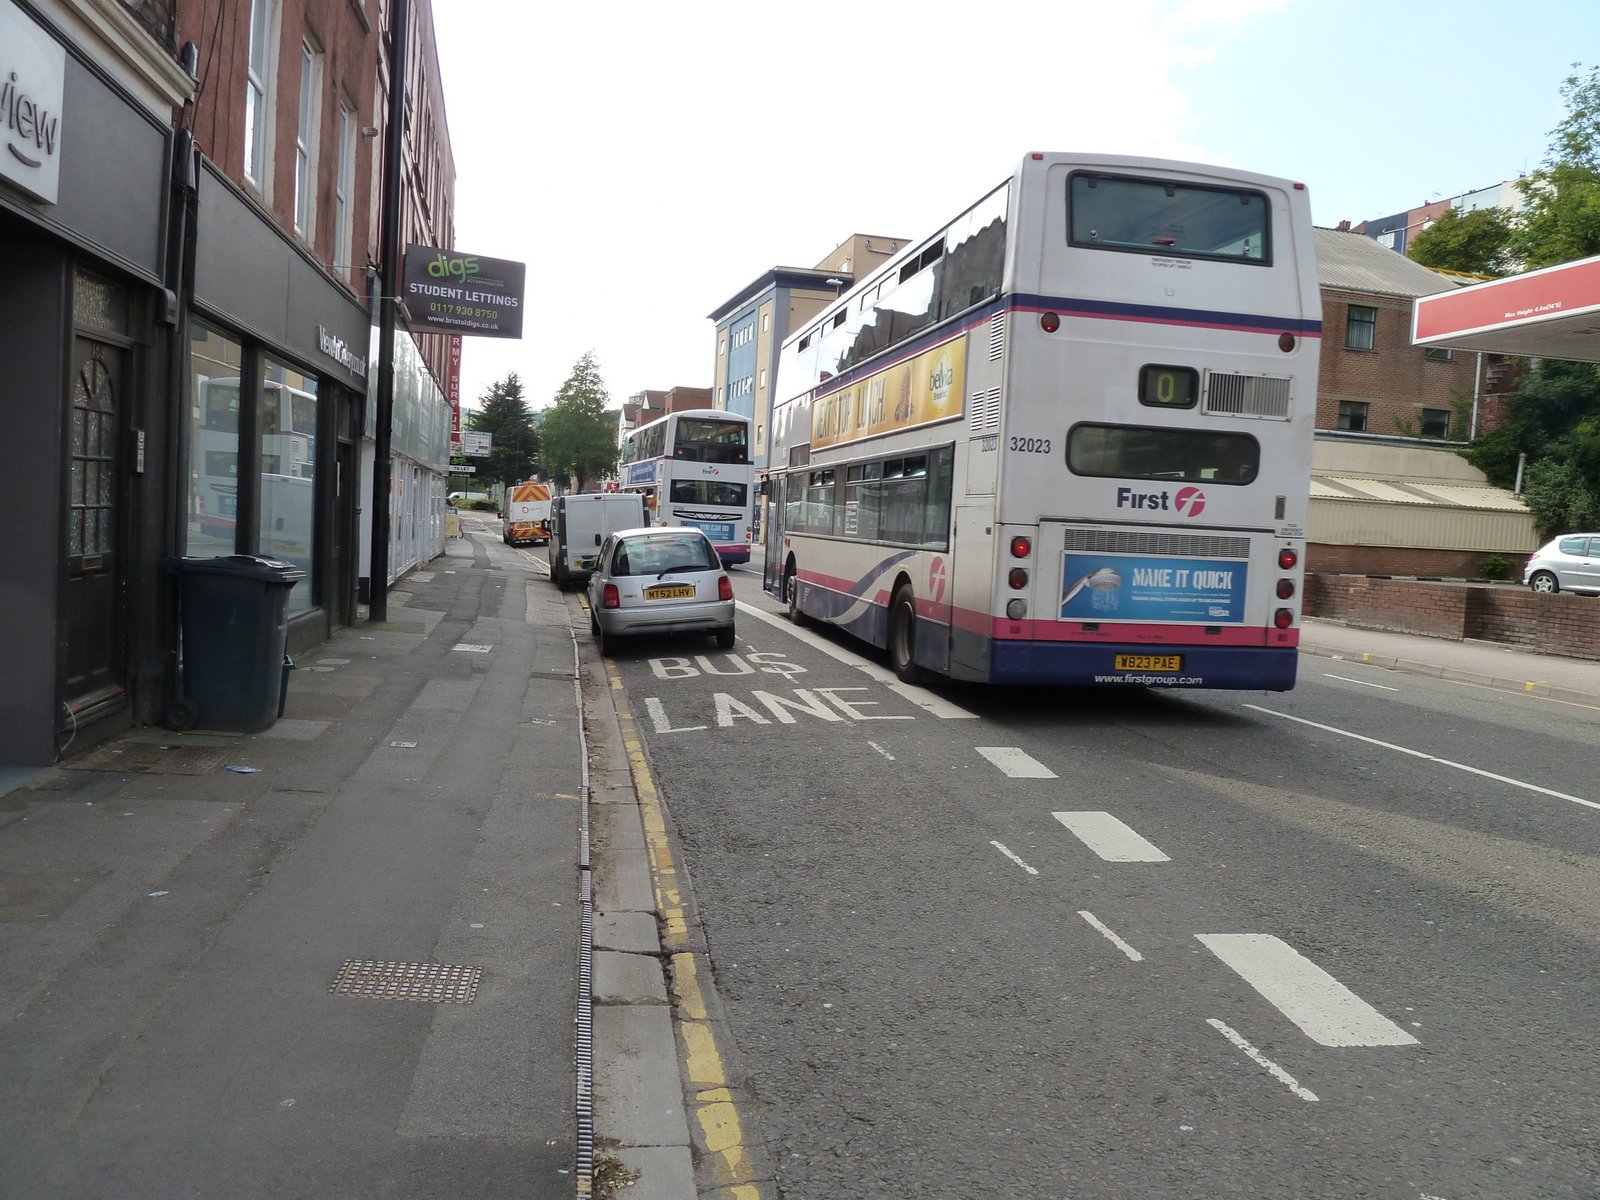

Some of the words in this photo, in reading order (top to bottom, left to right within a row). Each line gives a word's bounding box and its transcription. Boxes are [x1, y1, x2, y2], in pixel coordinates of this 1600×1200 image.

[427, 253, 480, 283] digs
[410, 283, 463, 300] STUDENT
[465, 291, 519, 307] LETTINGS
[430, 302, 453, 314] 0117
[456, 306, 473, 317] 930
[475, 309, 498, 320] 8750
[427, 315, 499, 330] www.bristoldigs.co.uk
[1157, 374, 1175, 403] 0
[1010, 437, 1051, 454] 32023
[1116, 487, 1169, 510] First
[1132, 568, 1172, 587] MAKE
[1175, 569, 1189, 588] IT
[1192, 570, 1233, 590] QUICK
[649, 590, 671, 599] MT52
[674, 588, 690, 597] LHV
[648, 653, 808, 680] BUS
[1121, 656, 1151, 669] W823
[1153, 658, 1175, 669] PAE
[1094, 673, 1203, 685] www.firstgroup.com
[644, 688, 916, 733] LANE
